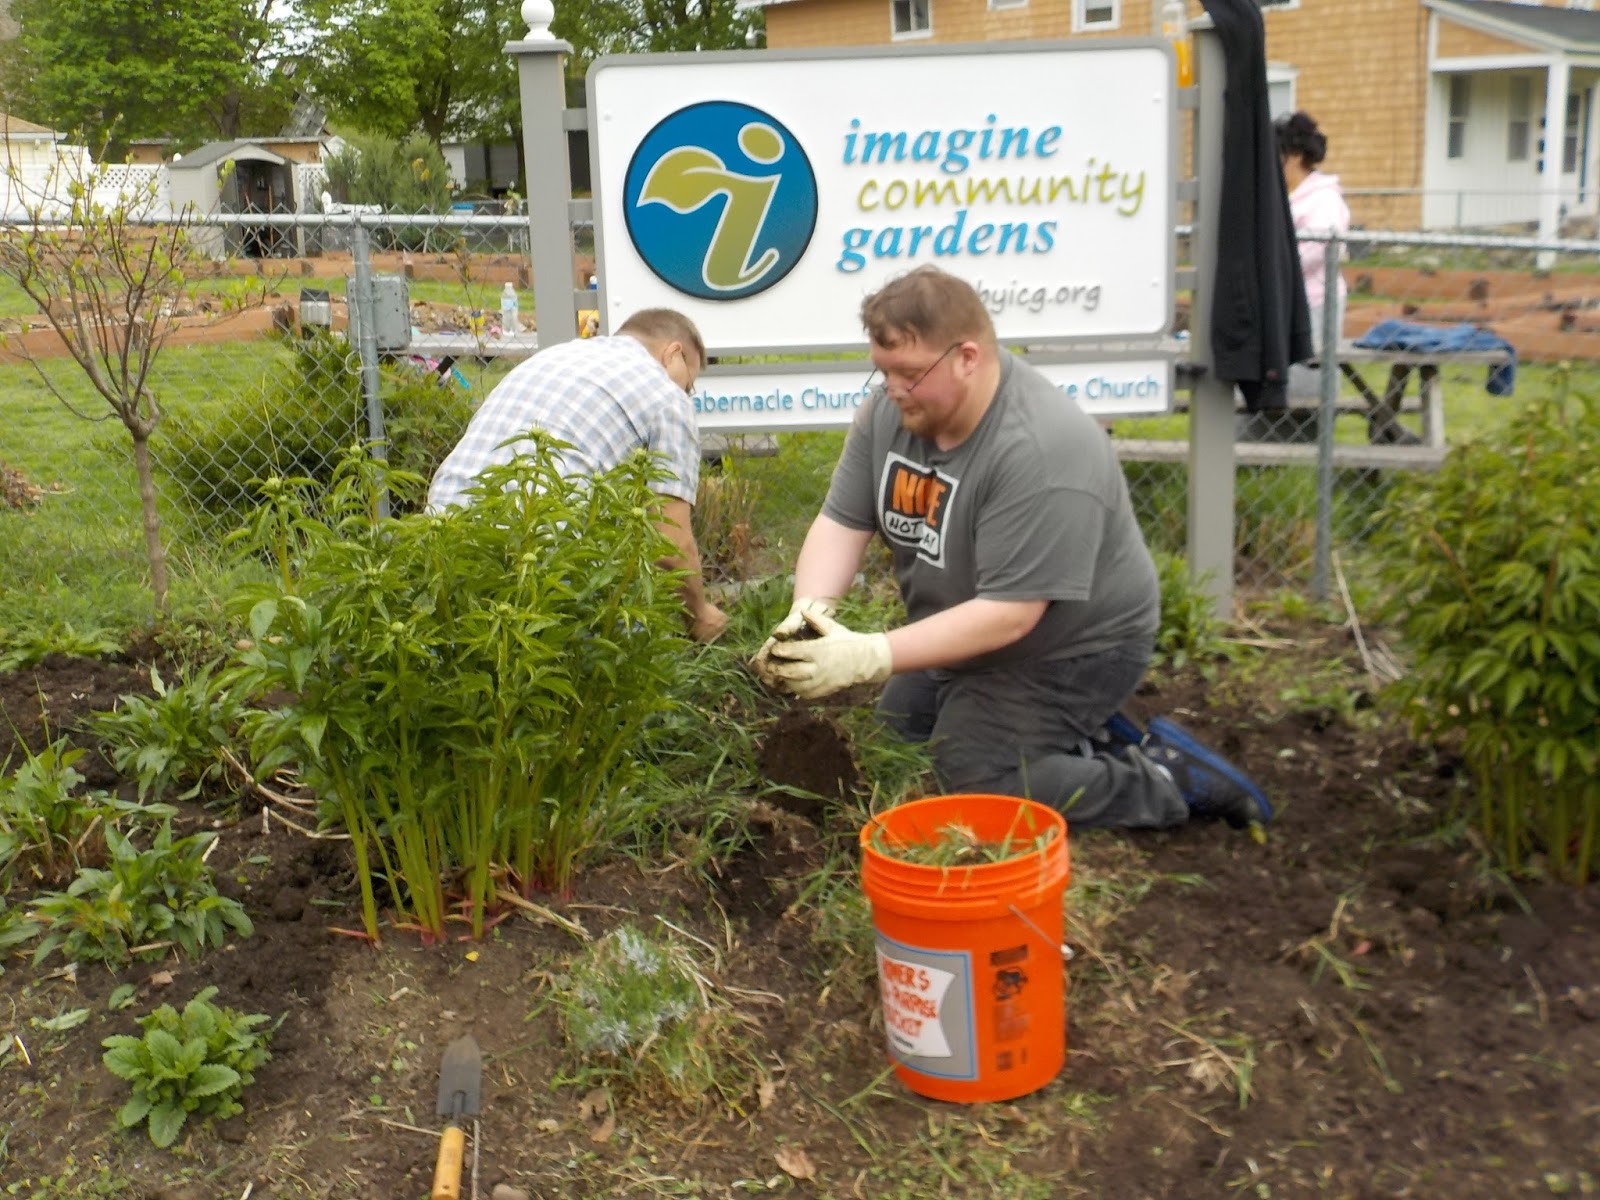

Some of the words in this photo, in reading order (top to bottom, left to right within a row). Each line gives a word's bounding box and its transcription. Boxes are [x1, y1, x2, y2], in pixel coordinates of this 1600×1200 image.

[842, 113, 1062, 175] imagine
[857, 157, 1145, 217] community
[836, 209, 1057, 273] gardens
[977, 280, 1101, 313] byicg.org
[691, 388, 794, 414] abernacle
[1085, 374, 1160, 400] Church
